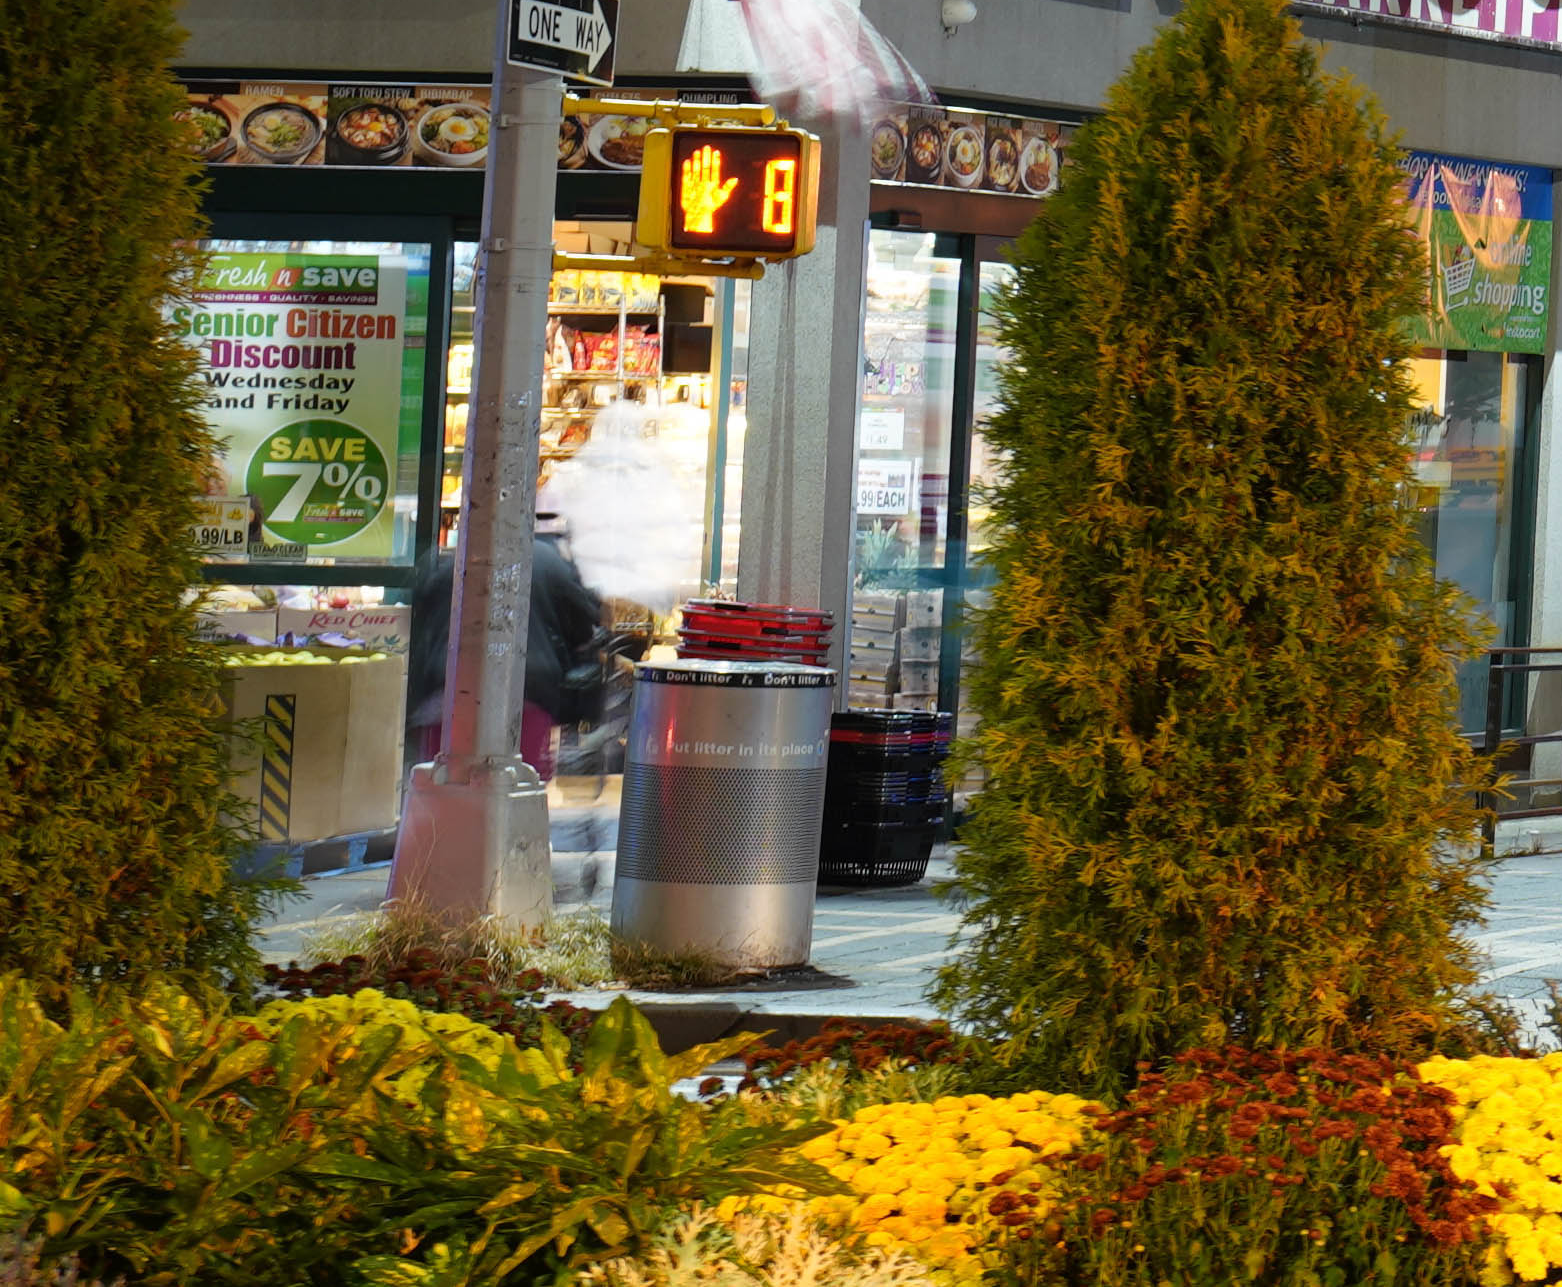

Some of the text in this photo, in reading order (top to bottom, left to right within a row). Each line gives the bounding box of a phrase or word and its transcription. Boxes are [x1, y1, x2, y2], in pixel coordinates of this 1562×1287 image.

[529, 5, 605, 53] ONE WAY
[246, 84, 284, 96] RAMEN
[332, 86, 411, 100] SOFT TOFU STEW
[420, 89, 474, 100] BIBIMBAP
[682, 93, 738, 104] DUMPLING
[762, 159, 797, 234] 8
[1490, 234, 1532, 267] online
[302, 265, 377, 287] save
[269, 293, 318, 302] QUALITY
[327, 294, 377, 303] SAVINGS
[1472, 273, 1546, 315] shopping
[172, 307, 397, 339] Senior Citizen
[209, 339, 356, 370] Discount
[203, 373, 356, 394] Wednesday
[208, 393, 350, 415] and Friday
[269, 437, 367, 462] SAVE
[262, 463, 382, 523] 7%
[308, 612, 401, 629] RED CHIEF
[666, 670, 733, 683] Don't litter
[763, 673, 821, 685] Don't litter
[695, 742, 735, 756] litter
[739, 743, 753, 757] in
[759, 743, 777, 756] its
[781, 743, 814, 757] place
